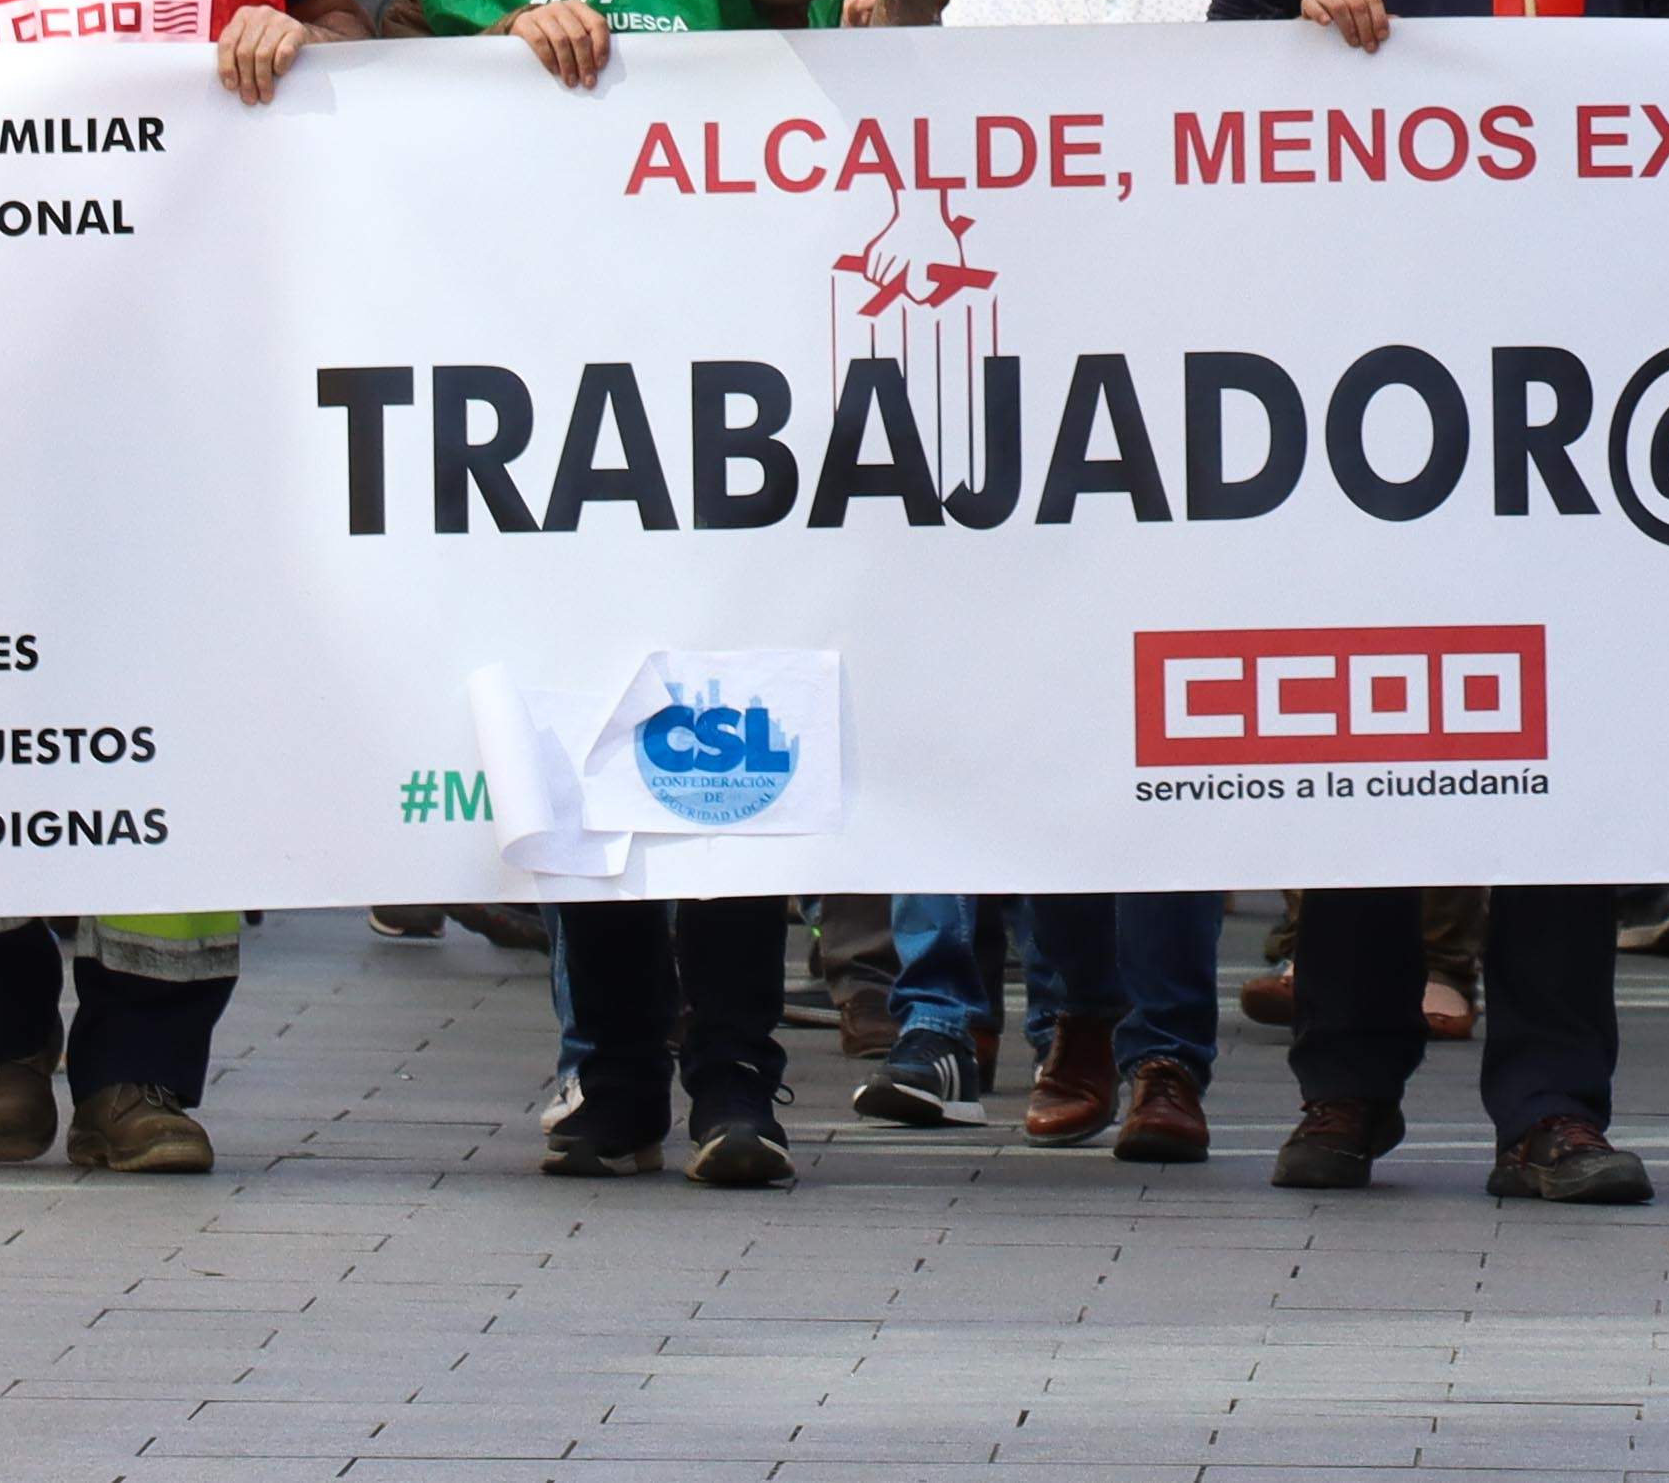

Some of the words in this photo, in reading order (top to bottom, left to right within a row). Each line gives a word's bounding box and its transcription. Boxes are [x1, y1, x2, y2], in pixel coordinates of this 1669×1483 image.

[11, 0, 142, 43] CCOO
[625, 114, 1132, 201] ALCALDE,
[1173, 105, 1537, 184] MENOS
[1163, 652, 1522, 738] CCOO
[642, 704, 791, 773] CSL
[400, 769, 494, 824] #M
[651, 772, 776, 788] CONFEDERACIÓN
[703, 791, 725, 804] DE
[1135, 770, 1286, 803] servicios
[1296, 777, 1315, 800] a
[1326, 770, 1355, 799] la
[1365, 767, 1550, 798] ciudadanía
[657, 787, 730, 821] SEGURIDAD
[734, 791, 775, 819] LOCAL
